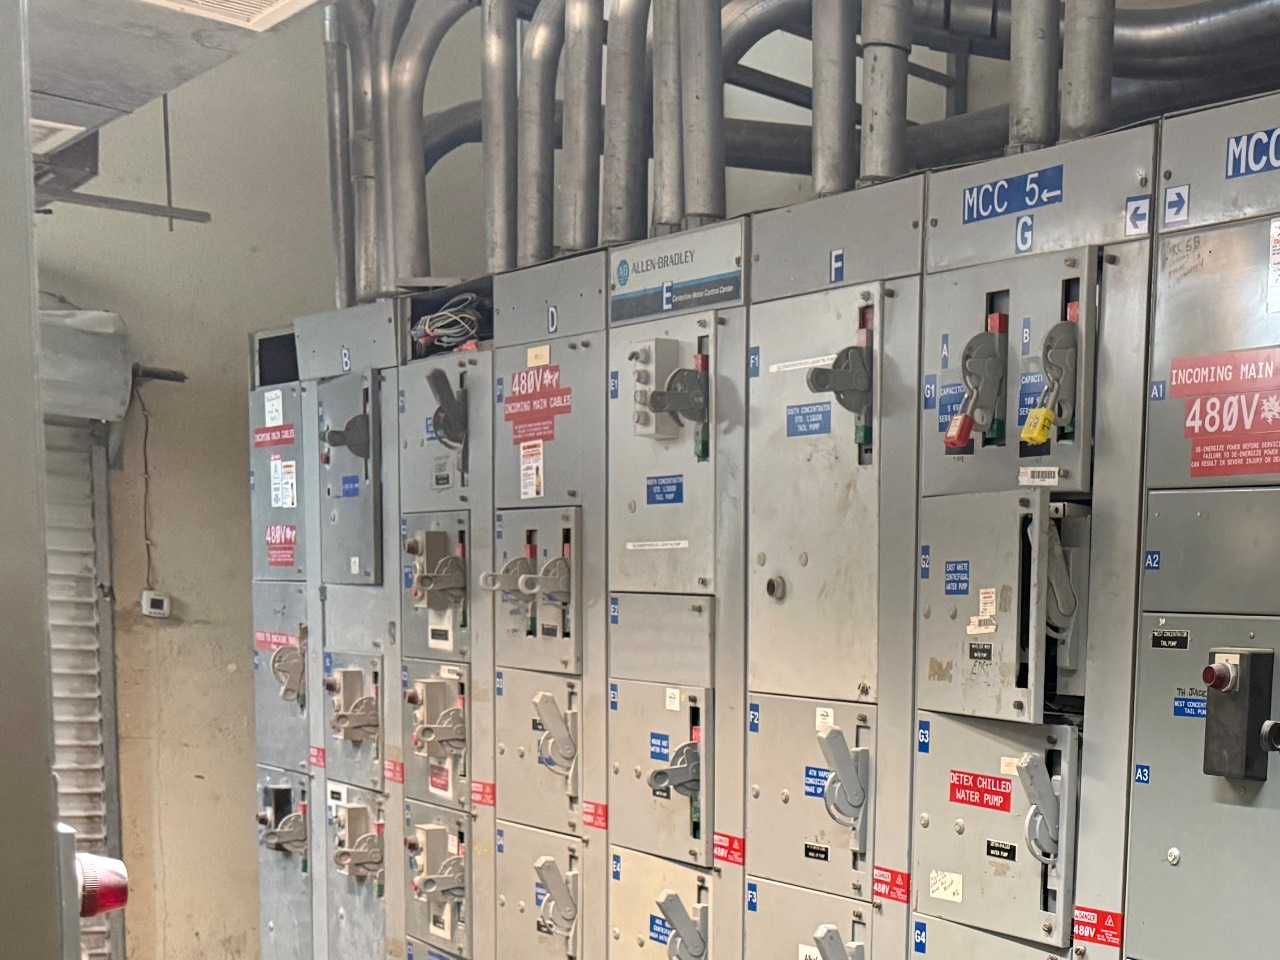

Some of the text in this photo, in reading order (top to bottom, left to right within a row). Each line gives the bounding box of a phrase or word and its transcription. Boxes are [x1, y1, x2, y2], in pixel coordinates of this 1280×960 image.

[964, 173, 1039, 221] MCC 5
[1016, 216, 1032, 251] G
[632, 250, 695, 273] ALLEN-BRADLEY
[831, 251, 843, 281] F
[662, 281, 672, 310] E
[547, 306, 558, 333] D
[341, 349, 351, 370] B
[1171, 365, 1233, 385] INCOMING
[1240, 361, 1274, 380] MAIN
[1151, 385, 1163, 398] A1
[1186, 393, 1259, 432] 480V
[1145, 555, 1159, 568] A2
[919, 730, 929, 743] G3
[950, 772, 1011, 792] DETEX CHILLED
[1136, 769, 1149, 781] A3
[956, 789, 1004, 806] WATER PUMP
[915, 931, 926, 944] G4
